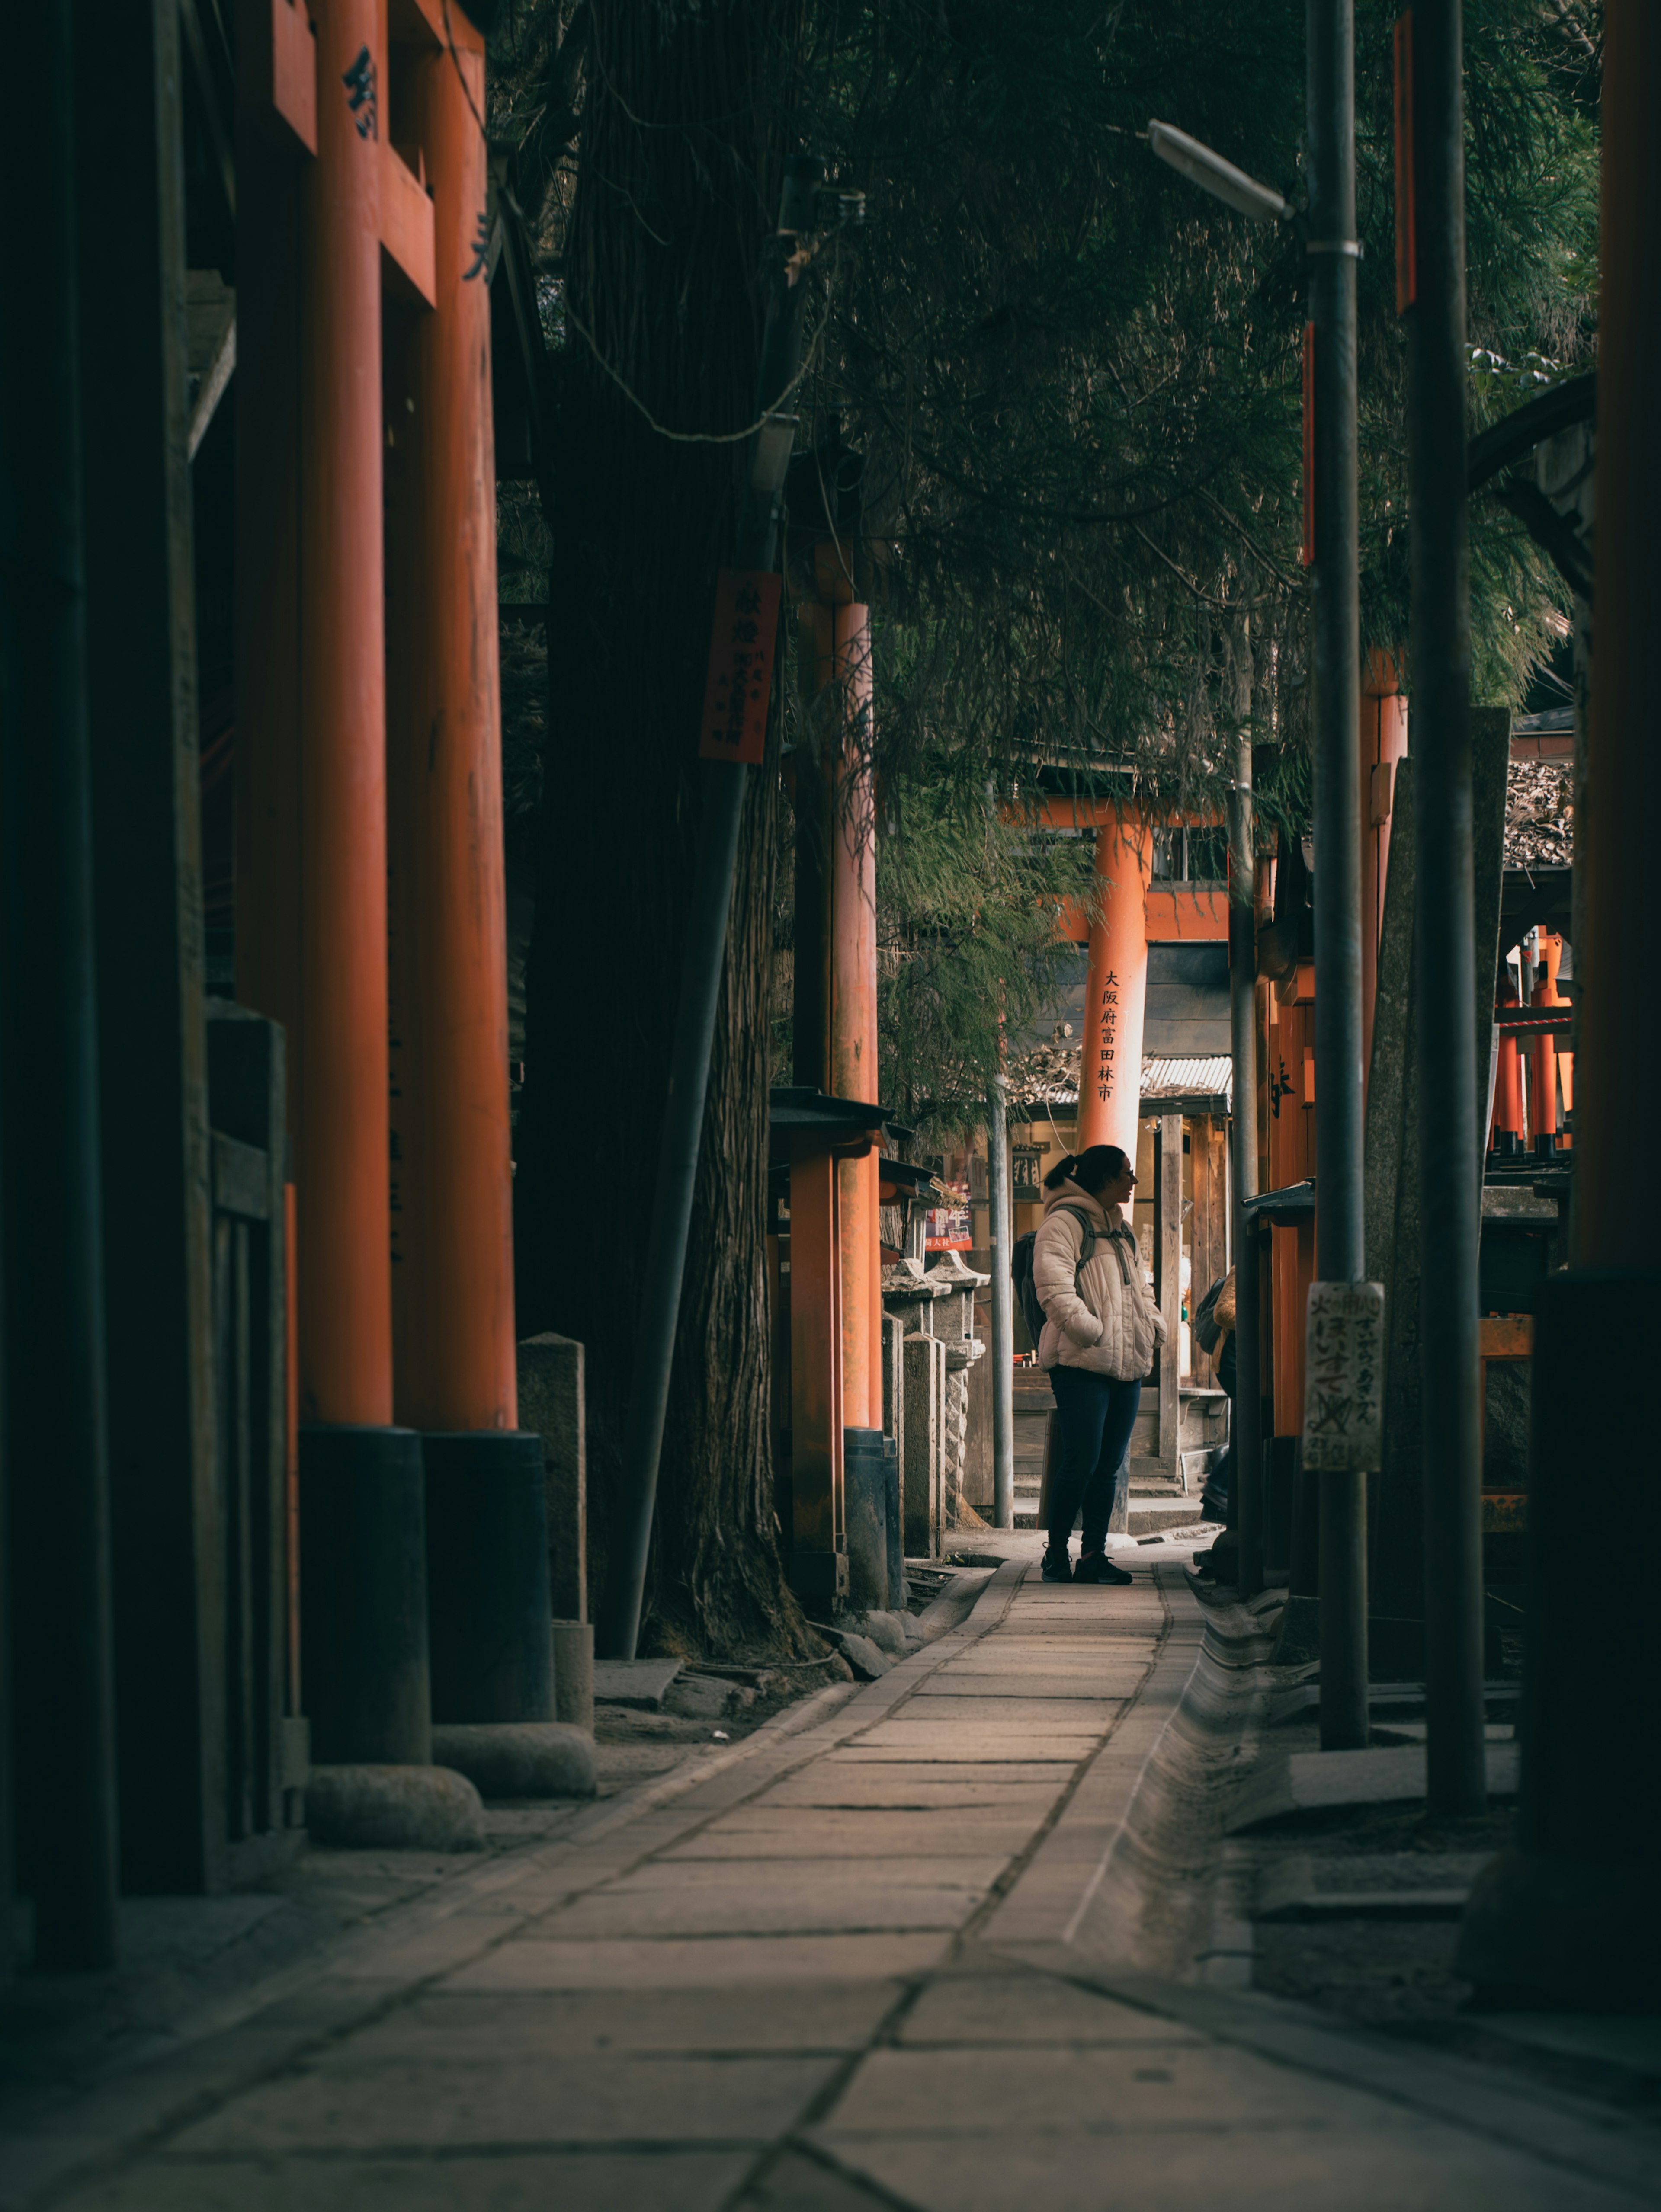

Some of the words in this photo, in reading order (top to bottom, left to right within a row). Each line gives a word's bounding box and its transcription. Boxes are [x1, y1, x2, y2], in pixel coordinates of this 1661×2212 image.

[1097, 970, 1119, 1102] 大阪府富田林市
